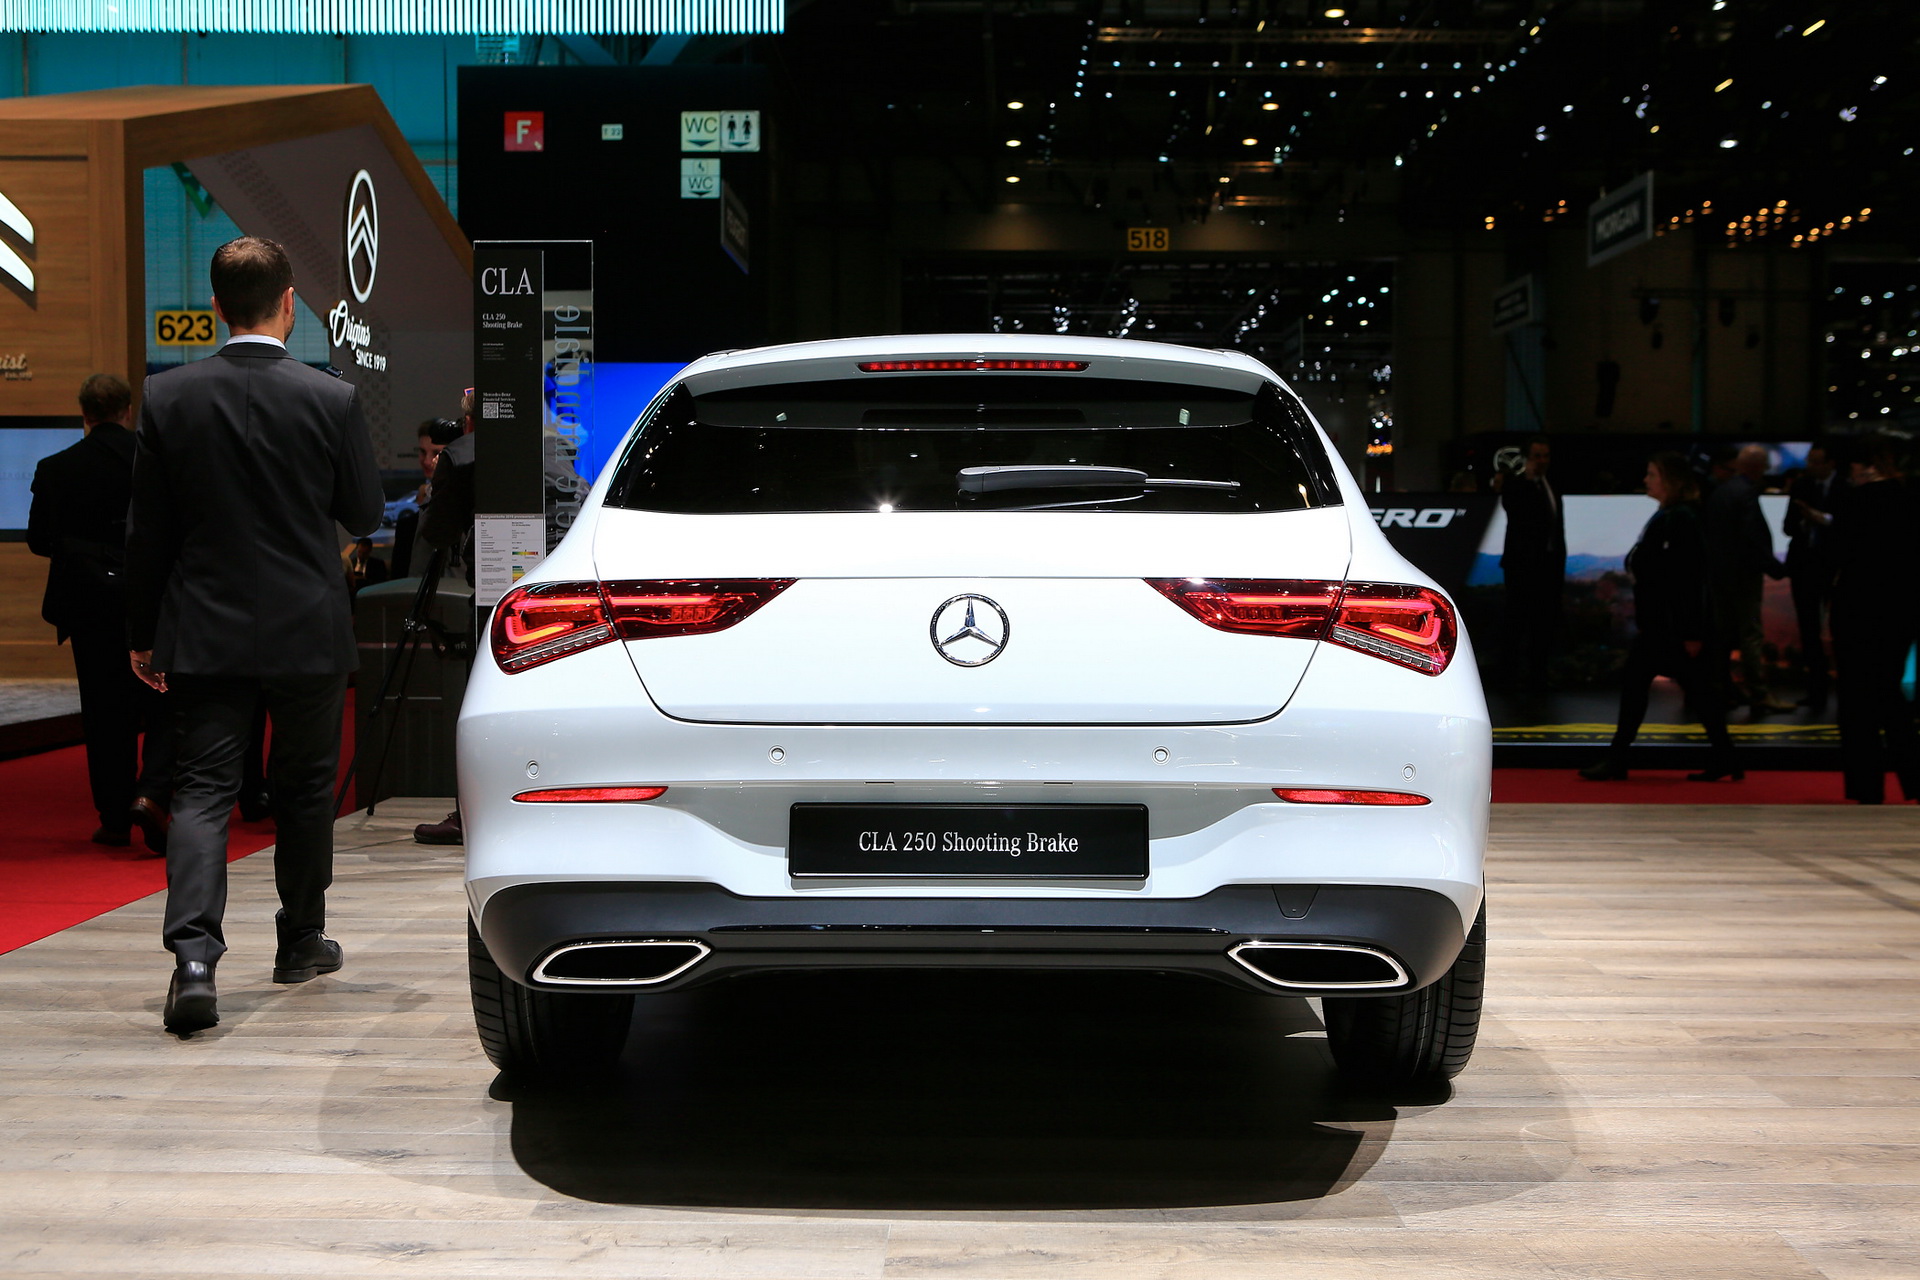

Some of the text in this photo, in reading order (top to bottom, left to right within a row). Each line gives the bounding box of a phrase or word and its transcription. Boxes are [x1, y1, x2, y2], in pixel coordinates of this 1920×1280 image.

[517, 120, 532, 144] F
[684, 116, 718, 134] WC
[688, 176, 714, 190] WC
[1131, 231, 1166, 249] 518
[481, 267, 535, 295] CLA
[329, 299, 371, 351] Origins
[482, 313, 506, 321] CLA 250
[482, 321, 523, 330] Shooting Brake
[158, 314, 214, 342] 623
[356, 348, 373, 369] SINCE
[858, 831, 1079, 857] CLA 250 Shooting Brake
